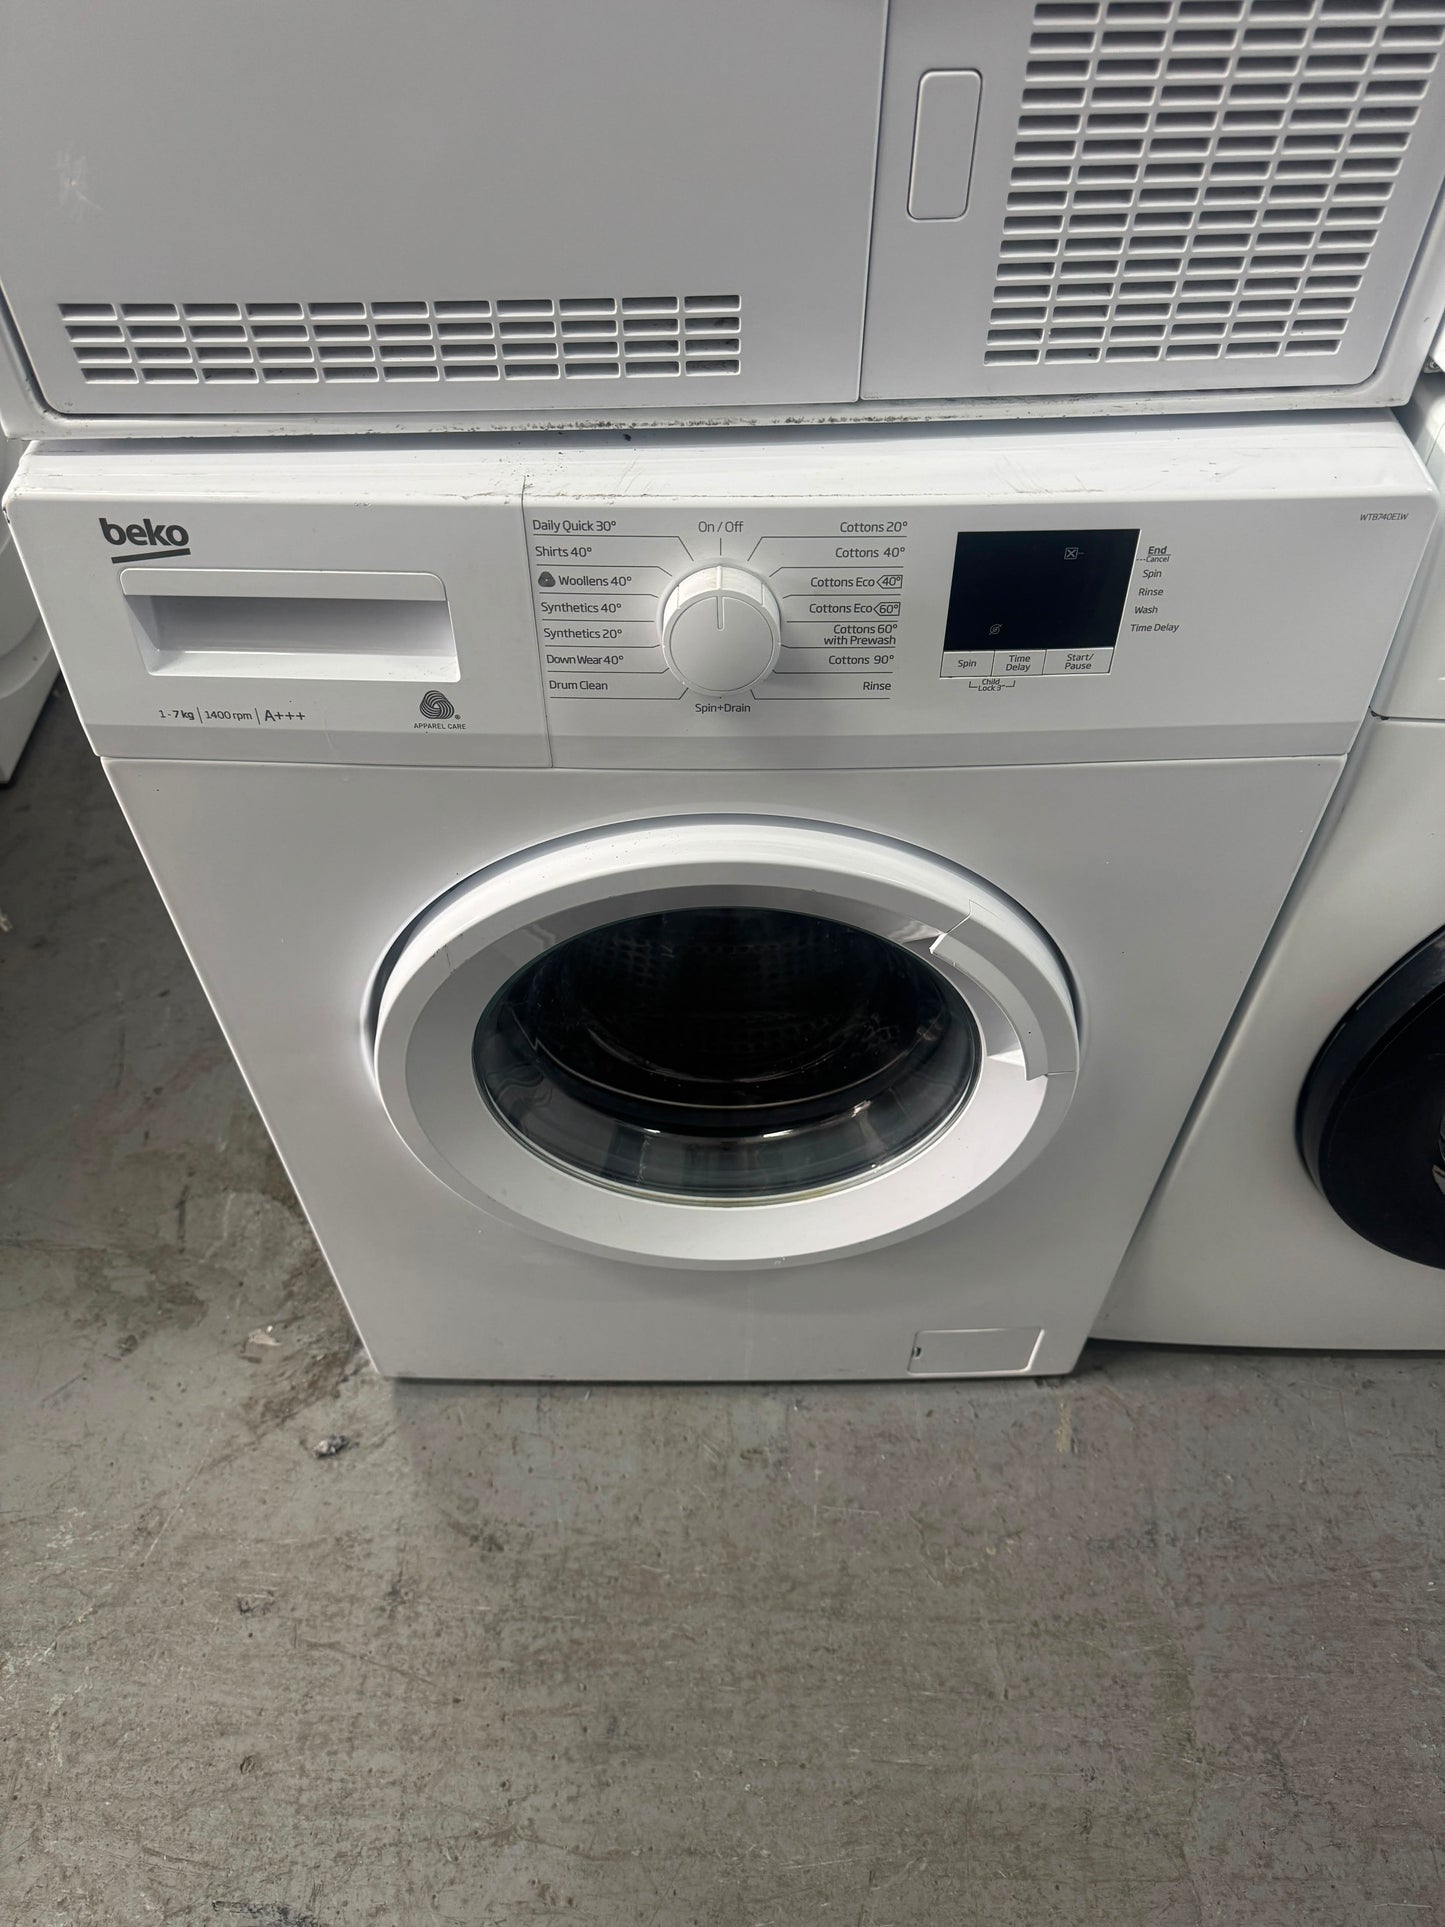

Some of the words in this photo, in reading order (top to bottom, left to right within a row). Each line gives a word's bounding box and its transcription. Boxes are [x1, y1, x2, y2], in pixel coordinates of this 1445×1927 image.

[99, 517, 190, 546] beko
[533, 520, 560, 533] Daily
[563, 520, 594, 533] Quick
[596, 520, 616, 531] 30°
[698, 521, 715, 532] On
[725, 521, 744, 533] Off
[840, 522, 884, 533] Cottons
[886, 522, 908, 533] 20°
[535, 546, 568, 557] Shirts
[571, 547, 592, 557] 40°
[835, 547, 879, 558] Cottons
[884, 547, 905, 557] 40°
[1148, 546, 1167, 555] End
[1146, 555, 1170, 563] Cancel
[1142, 569, 1162, 579] Spin
[558, 576, 609, 586] Woollens
[611, 576, 632, 586] 40°
[810, 577, 854, 588] Cottons
[856, 577, 875, 587] Eco
[1138, 588, 1164, 596] Rinse
[541, 602, 599, 614] Synthetics
[601, 603, 622, 613] 40°
[809, 603, 852, 614] Cottons
[854, 603, 873, 613] Eco
[1134, 606, 1158, 614] Wash
[833, 624, 875, 634] Cottons
[878, 624, 898, 634] 60°
[1131, 624, 1152, 632] Time
[1154, 624, 1180, 633] Delay
[544, 628, 601, 640] Synthetics
[603, 629, 622, 638] 20°
[824, 636, 848, 645] with
[850, 635, 896, 645] Prewash
[546, 654, 576, 664] Down
[577, 655, 602, 664] Wear
[604, 655, 624, 665] 40°
[828, 655, 870, 665] Cottons
[874, 655, 894, 664] 90°
[1009, 655, 1030, 663] Time
[1067, 653, 1094, 662] Start/
[957, 659, 977, 668] Spin
[1005, 663, 1031, 672] Delay
[1064, 662, 1092, 670] Pause
[549, 680, 577, 690] Drum
[580, 681, 608, 690] Clean
[863, 681, 892, 691] Rinse
[695, 703, 751, 714] Spin+Drain
[204, 710, 232, 720] 1400
[233, 712, 253, 721] rpm
[264, 709, 306, 722] A+++
[413, 722, 446, 730] APPAREL
